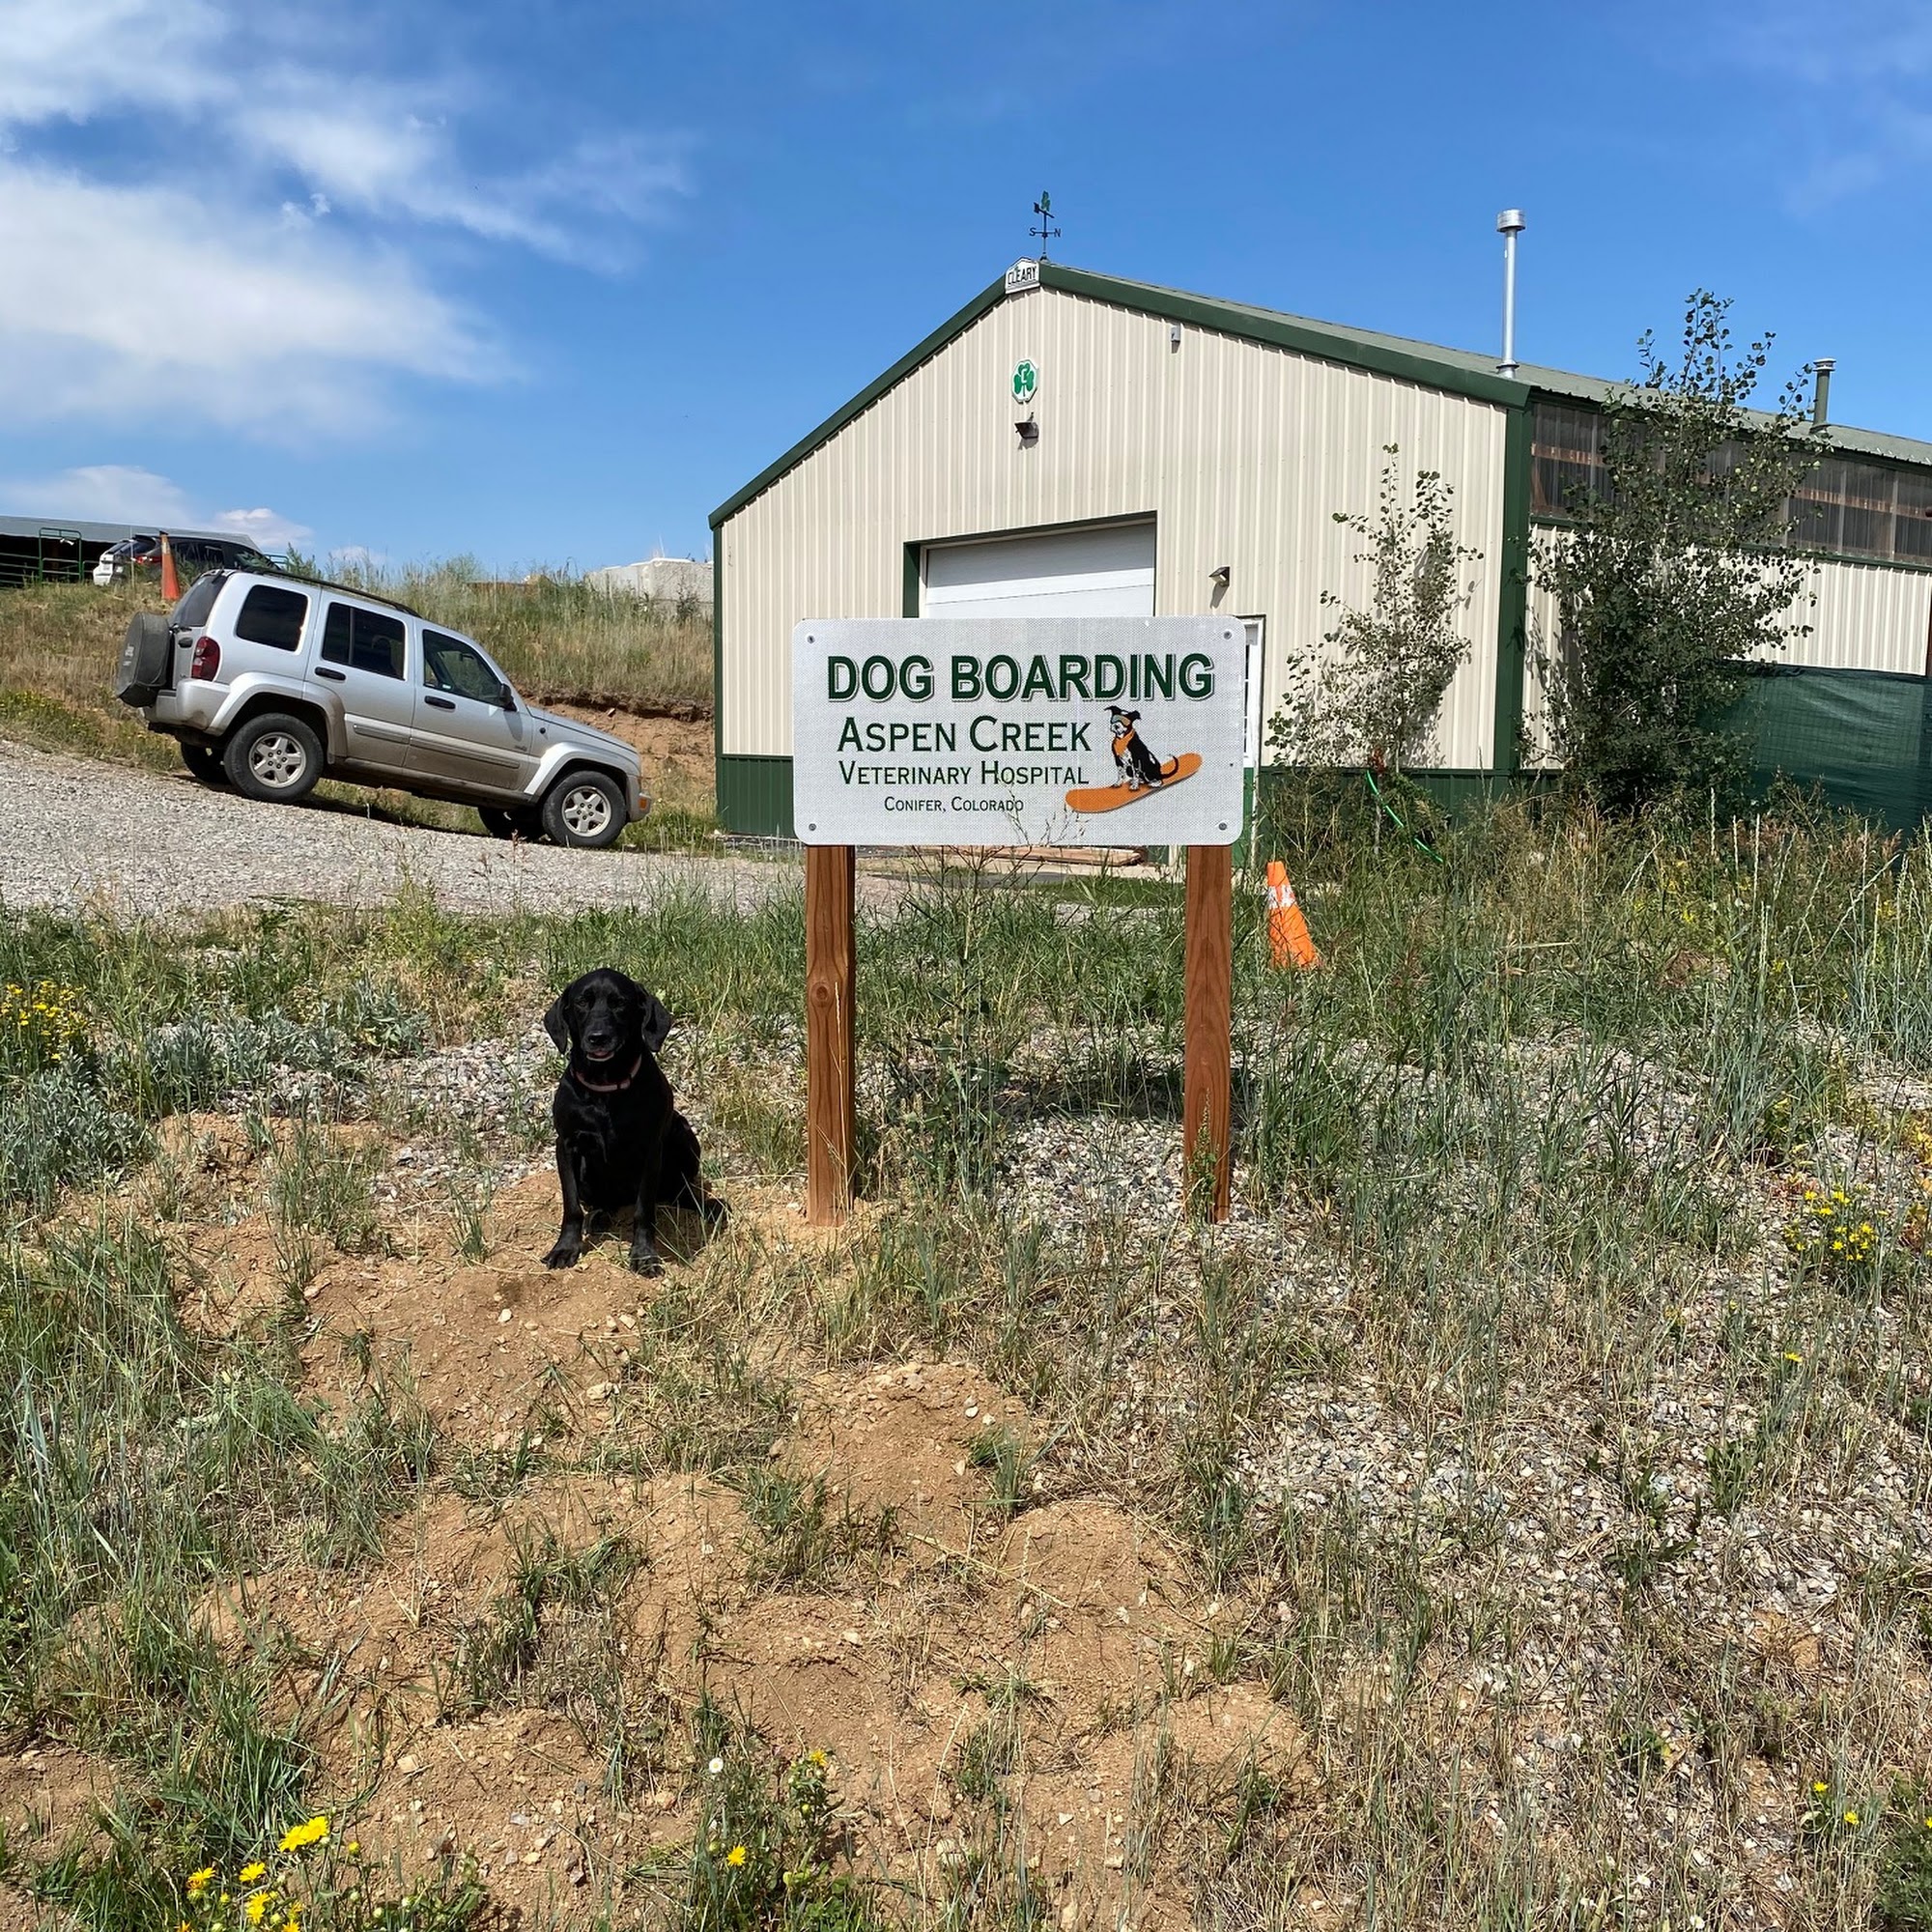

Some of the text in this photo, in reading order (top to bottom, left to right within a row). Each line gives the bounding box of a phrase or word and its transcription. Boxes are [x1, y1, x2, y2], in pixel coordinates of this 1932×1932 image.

[1008, 266, 1037, 285] CLEARY
[827, 653, 1214, 702] DOG BOARDING
[837, 715, 1092, 753] ASPEN CREEK
[838, 760, 1090, 784] VETERINARY HOSPITAL
[884, 796, 1024, 813] CONIFER, COLORADO
